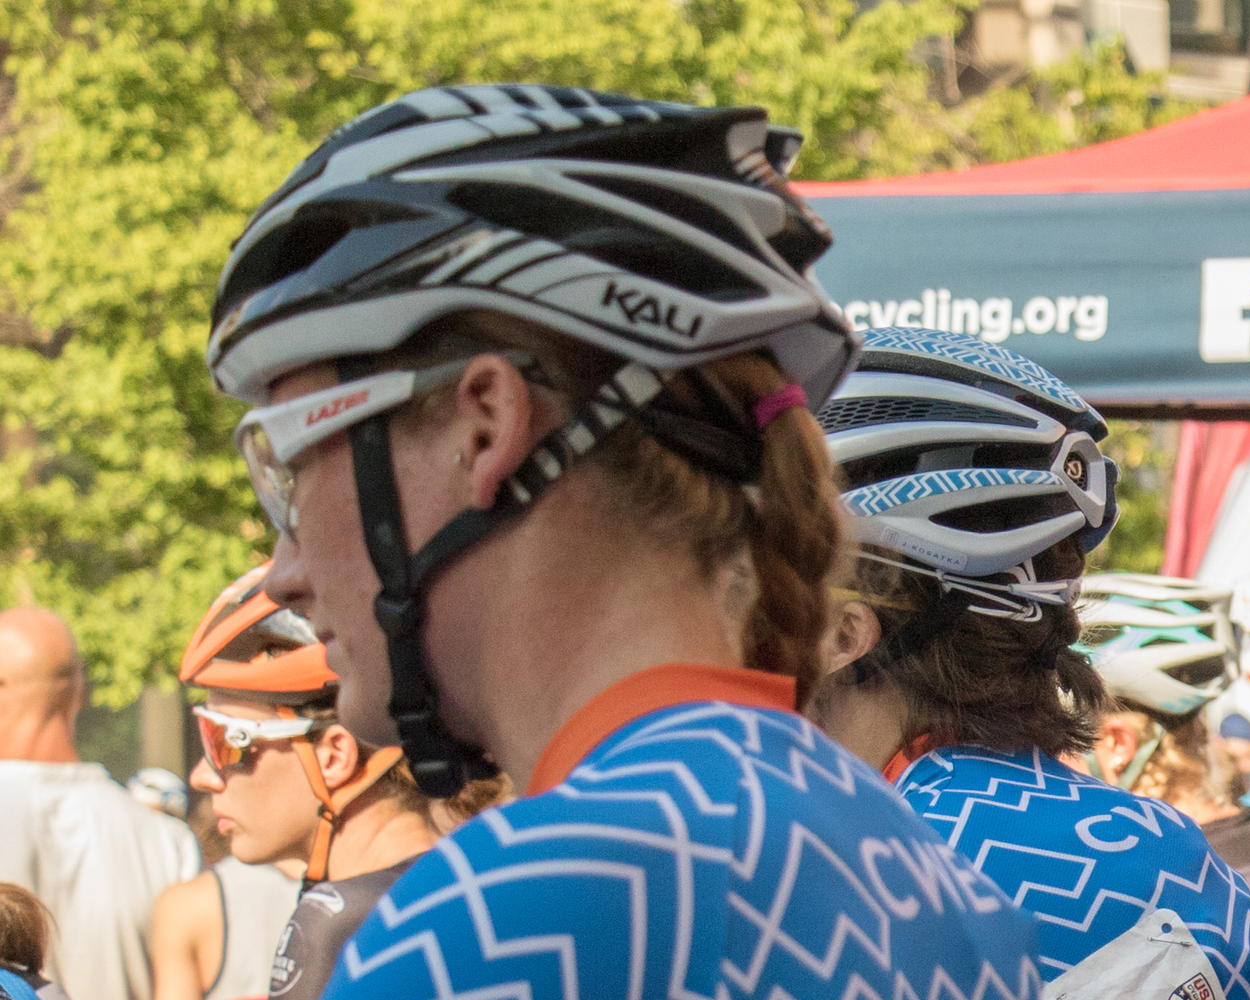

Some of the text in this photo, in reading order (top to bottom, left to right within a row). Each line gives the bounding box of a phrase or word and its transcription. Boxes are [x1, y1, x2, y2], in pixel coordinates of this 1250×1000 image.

[602, 280, 704, 338] KALI
[830, 288, 1109, 342] cycling.org
[306, 389, 371, 427] LAZER
[911, 545, 961, 566] KOSATKA
[1074, 799, 1188, 852] CW
[859, 837, 1002, 920] CWE
